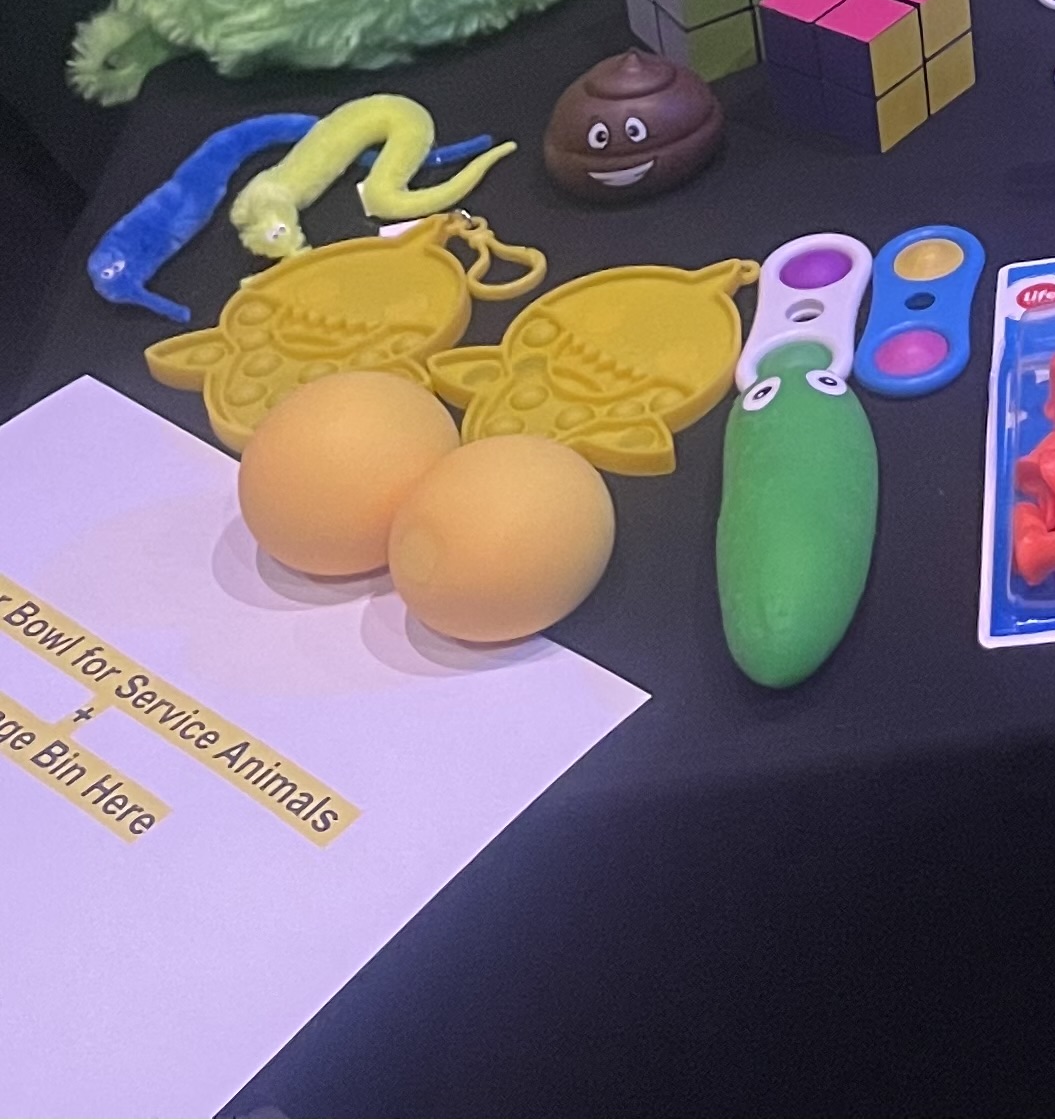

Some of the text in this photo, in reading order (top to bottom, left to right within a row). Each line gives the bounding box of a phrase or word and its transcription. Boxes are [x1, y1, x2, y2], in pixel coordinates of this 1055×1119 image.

[3, 600, 339, 833] Bowl for Service Animals
[30, 740, 87, 786] Bin
[80, 774, 156, 835] Here
